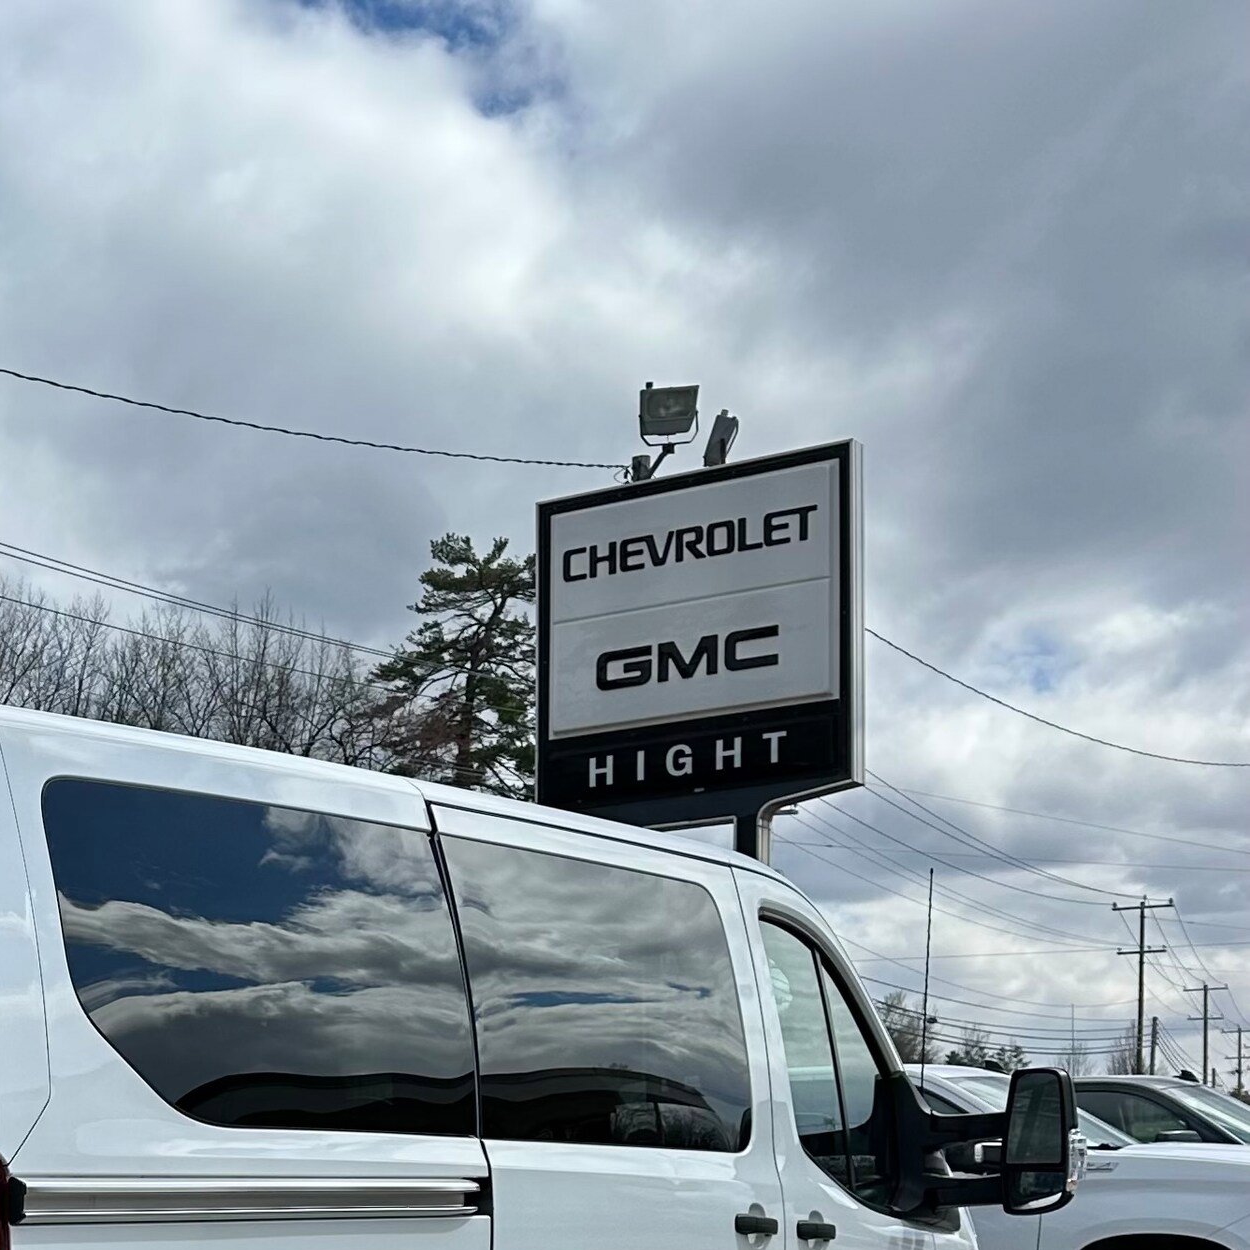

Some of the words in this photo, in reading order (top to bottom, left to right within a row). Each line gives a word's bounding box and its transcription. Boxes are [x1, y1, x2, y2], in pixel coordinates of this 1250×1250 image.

[562, 504, 818, 583] CHEVROLET
[596, 624, 780, 691] GMC
[588, 730, 787, 788] HIGHT
